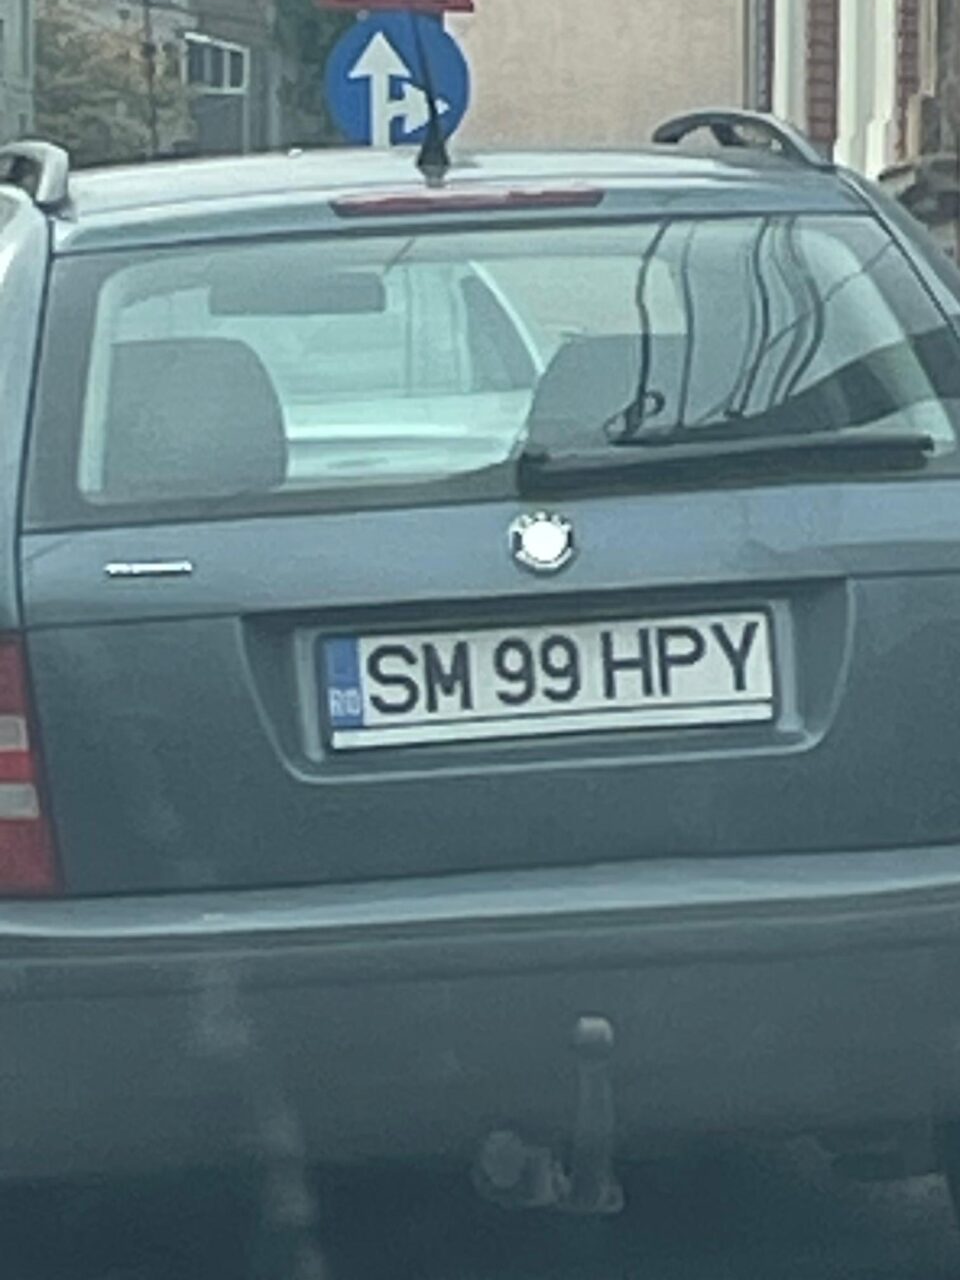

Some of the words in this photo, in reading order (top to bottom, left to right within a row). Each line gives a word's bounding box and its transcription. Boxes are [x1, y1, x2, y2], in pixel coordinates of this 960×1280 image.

[366, 640, 475, 715] SM
[493, 634, 581, 705] 99
[600, 621, 760, 700] HPY
[328, 686, 362, 719] RO
